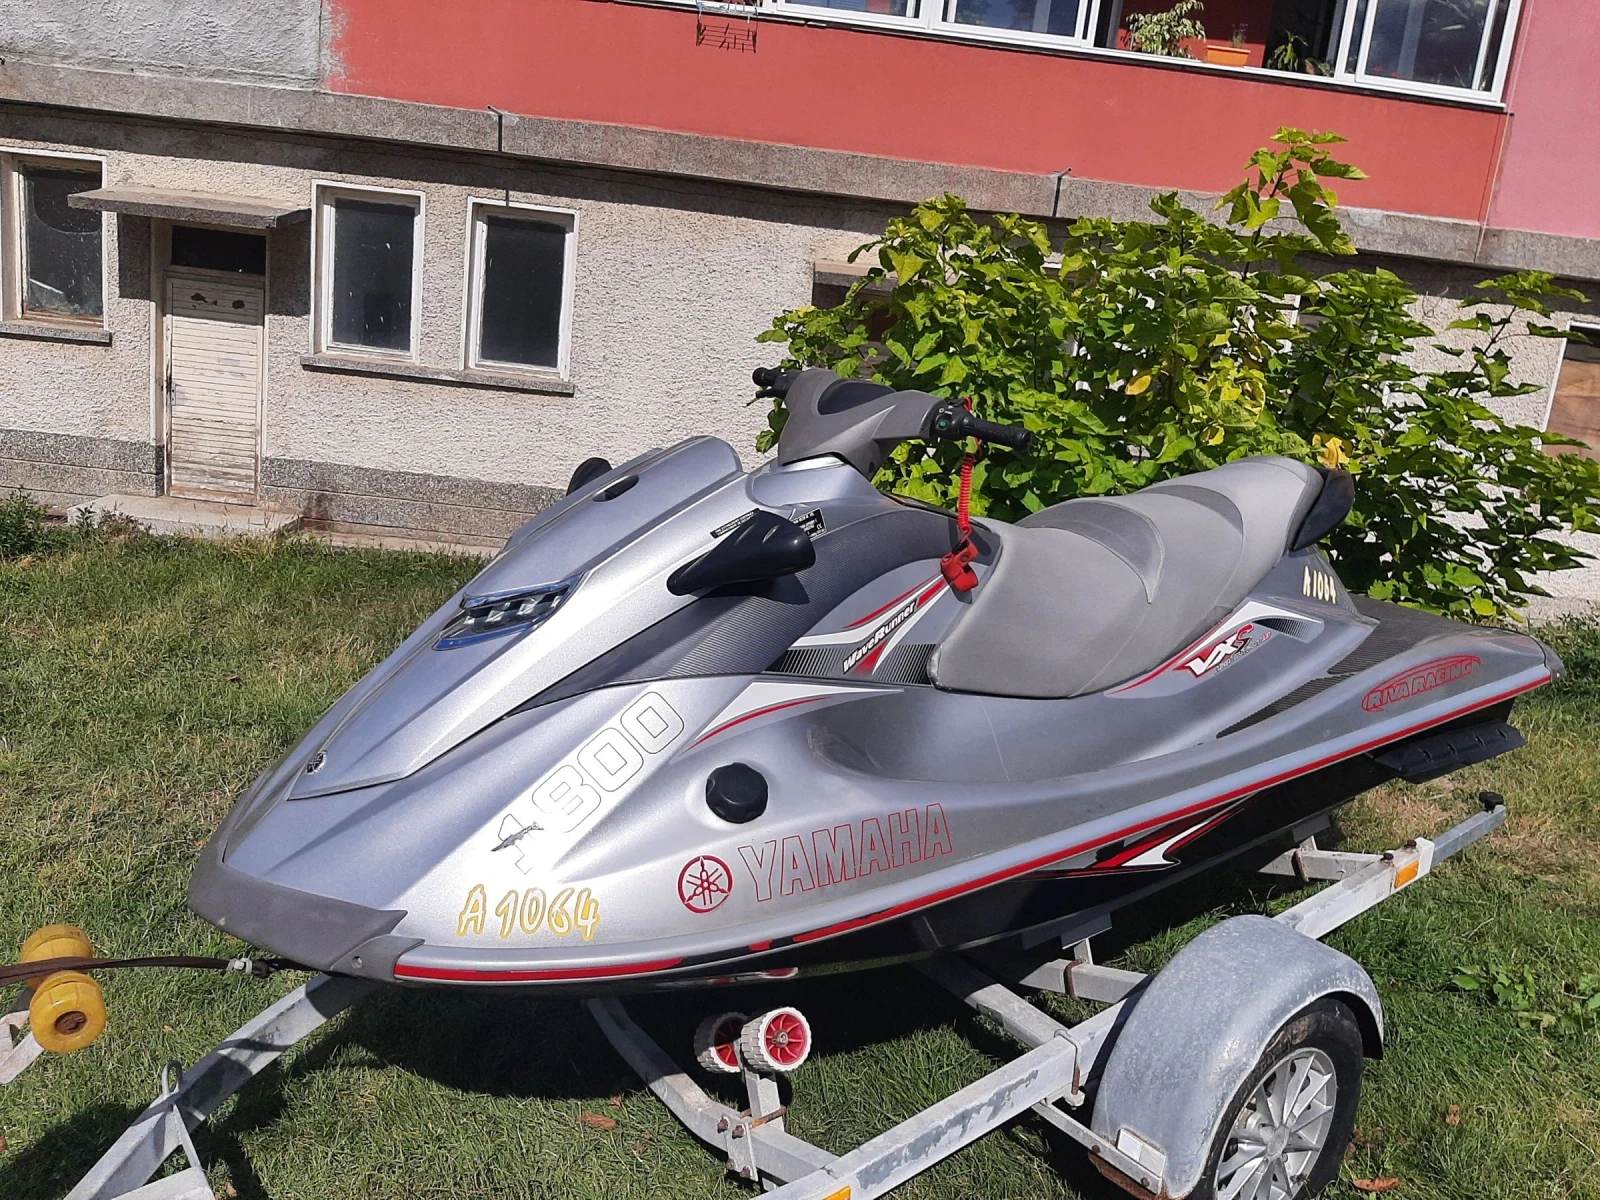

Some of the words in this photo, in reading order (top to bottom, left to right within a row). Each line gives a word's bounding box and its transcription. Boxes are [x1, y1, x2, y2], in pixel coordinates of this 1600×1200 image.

[843, 600, 916, 674] WaveRunner
[1366, 681, 1410, 708] RIVA
[497, 691, 685, 875] 1800
[737, 802, 953, 903] YAMAHA
[495, 887, 600, 942] 1064
